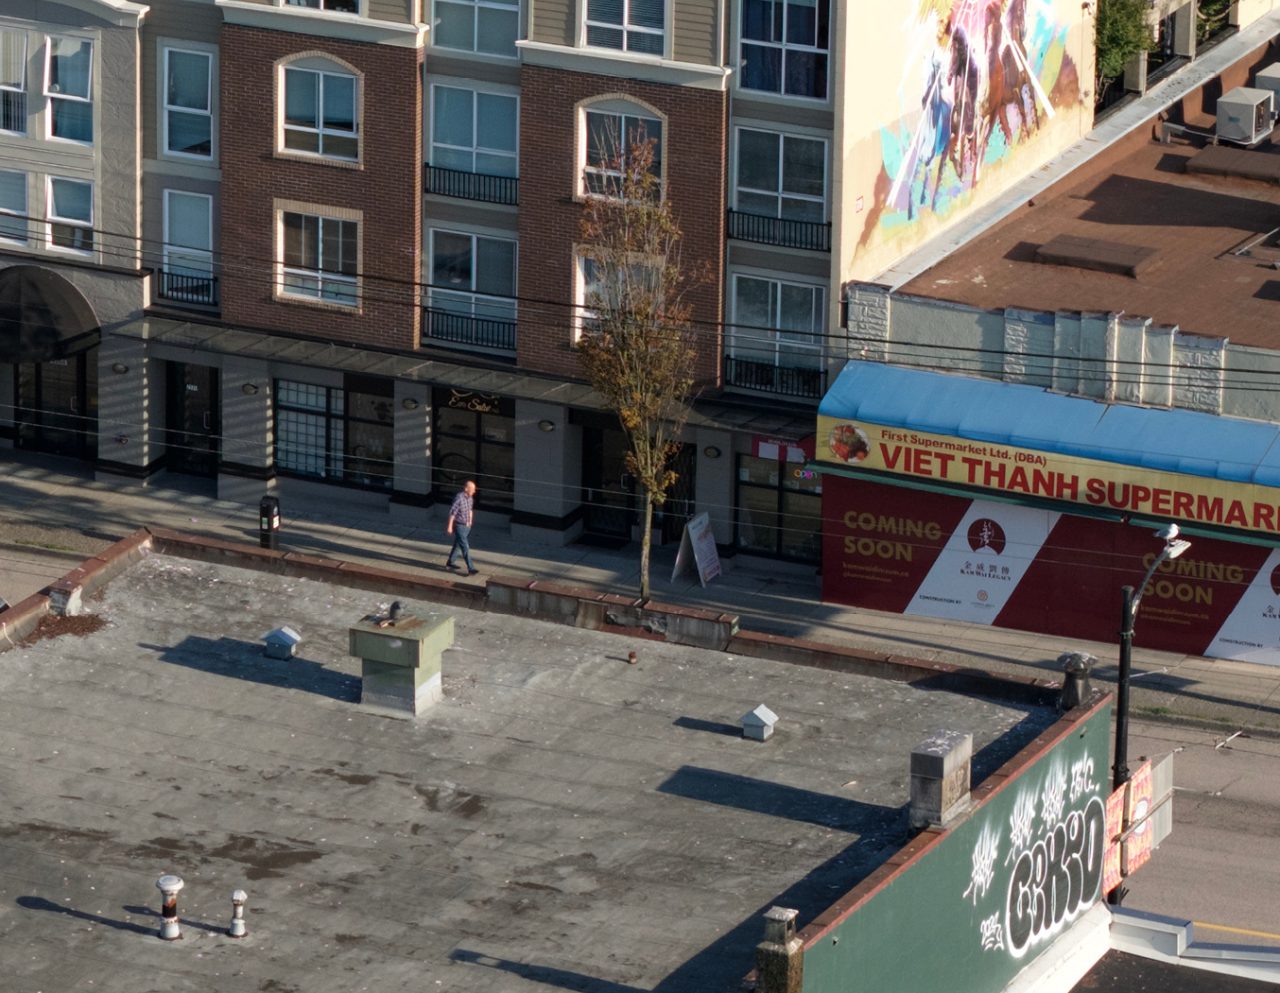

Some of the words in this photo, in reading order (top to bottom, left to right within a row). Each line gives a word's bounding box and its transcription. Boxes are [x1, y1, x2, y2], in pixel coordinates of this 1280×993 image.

[881, 430, 907, 443] First
[910, 435, 987, 456] Supermarket
[989, 447, 1011, 460] Ltd.
[1014, 451, 1047, 468] (DBA)
[879, 443, 955, 479] VIET
[962, 457, 1079, 501] THANH
[1085, 478, 1280, 531] SUPERMAR
[843, 511, 942, 540] COMING
[844, 536, 913, 561] SOON
[1142, 552, 1244, 583] COMING
